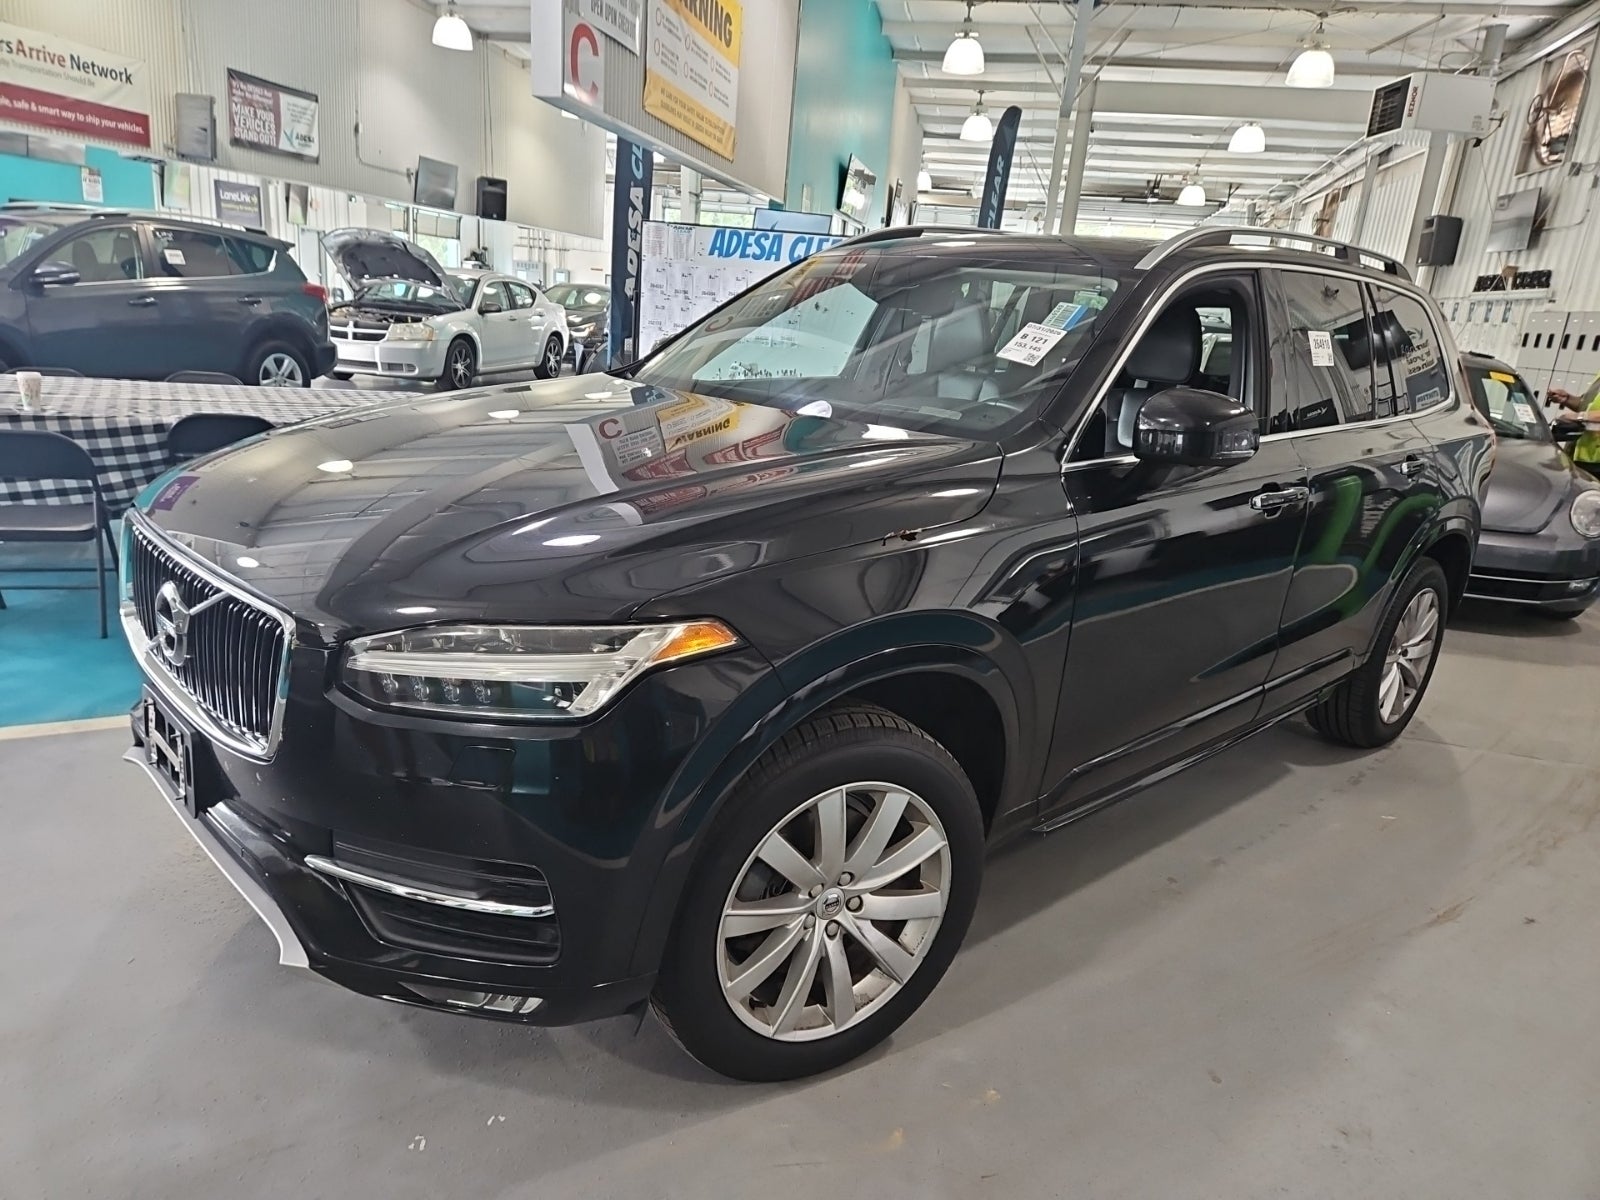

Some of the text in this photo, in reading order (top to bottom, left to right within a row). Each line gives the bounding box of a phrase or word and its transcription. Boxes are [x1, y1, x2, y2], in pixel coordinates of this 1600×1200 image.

[70, 53, 133, 85] Network
[570, 22, 599, 106] C
[13, 99, 30, 112] safe
[31, 101, 37, 112] &
[38, 104, 60, 117] smart
[61, 109, 75, 121] way
[77, 111, 84, 122] to
[86, 113, 100, 126] ship
[101, 118, 116, 129] your
[117, 121, 144, 135] vehicles.
[232, 102, 255, 118] MAKE
[256, 109, 275, 123] YOUR
[1407, 86, 1419, 117] REZNOR
[233, 112, 276, 134] VEHICLES
[234, 127, 259, 143] STAND
[220, 189, 251, 204] LaneLink
[624, 187, 644, 302] ADESA
[708, 228, 784, 262] ADESA
[1031, 335, 1048, 345] 121
